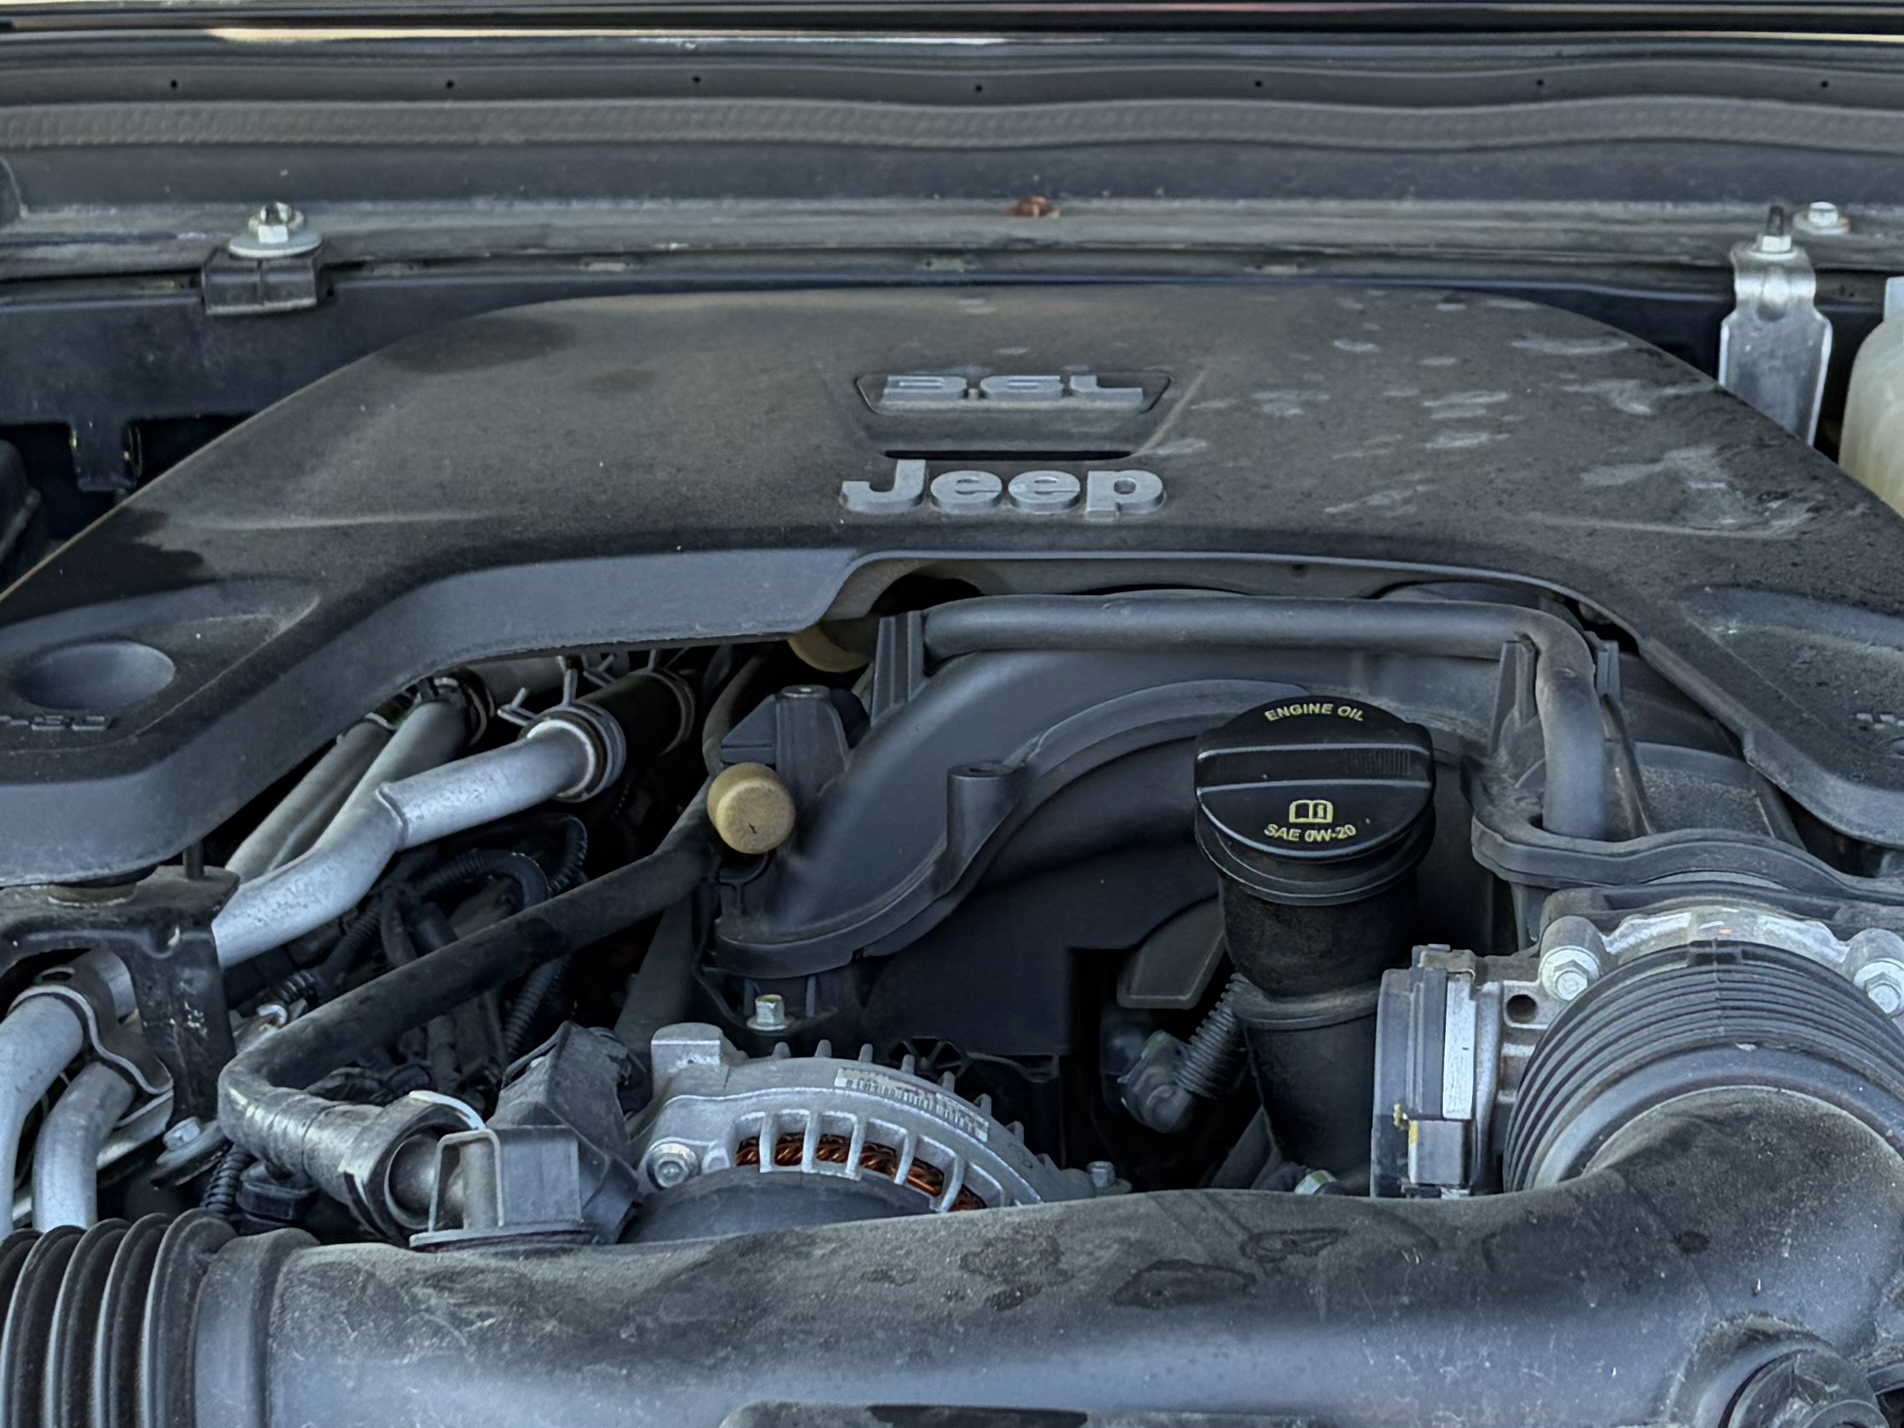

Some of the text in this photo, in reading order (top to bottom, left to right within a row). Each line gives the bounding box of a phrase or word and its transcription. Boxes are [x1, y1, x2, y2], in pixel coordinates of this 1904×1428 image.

[840, 458, 1165, 521] Jeep
[1264, 703, 1364, 722] ENGINE OIL
[1264, 823, 1357, 843] SAE 0W-20
